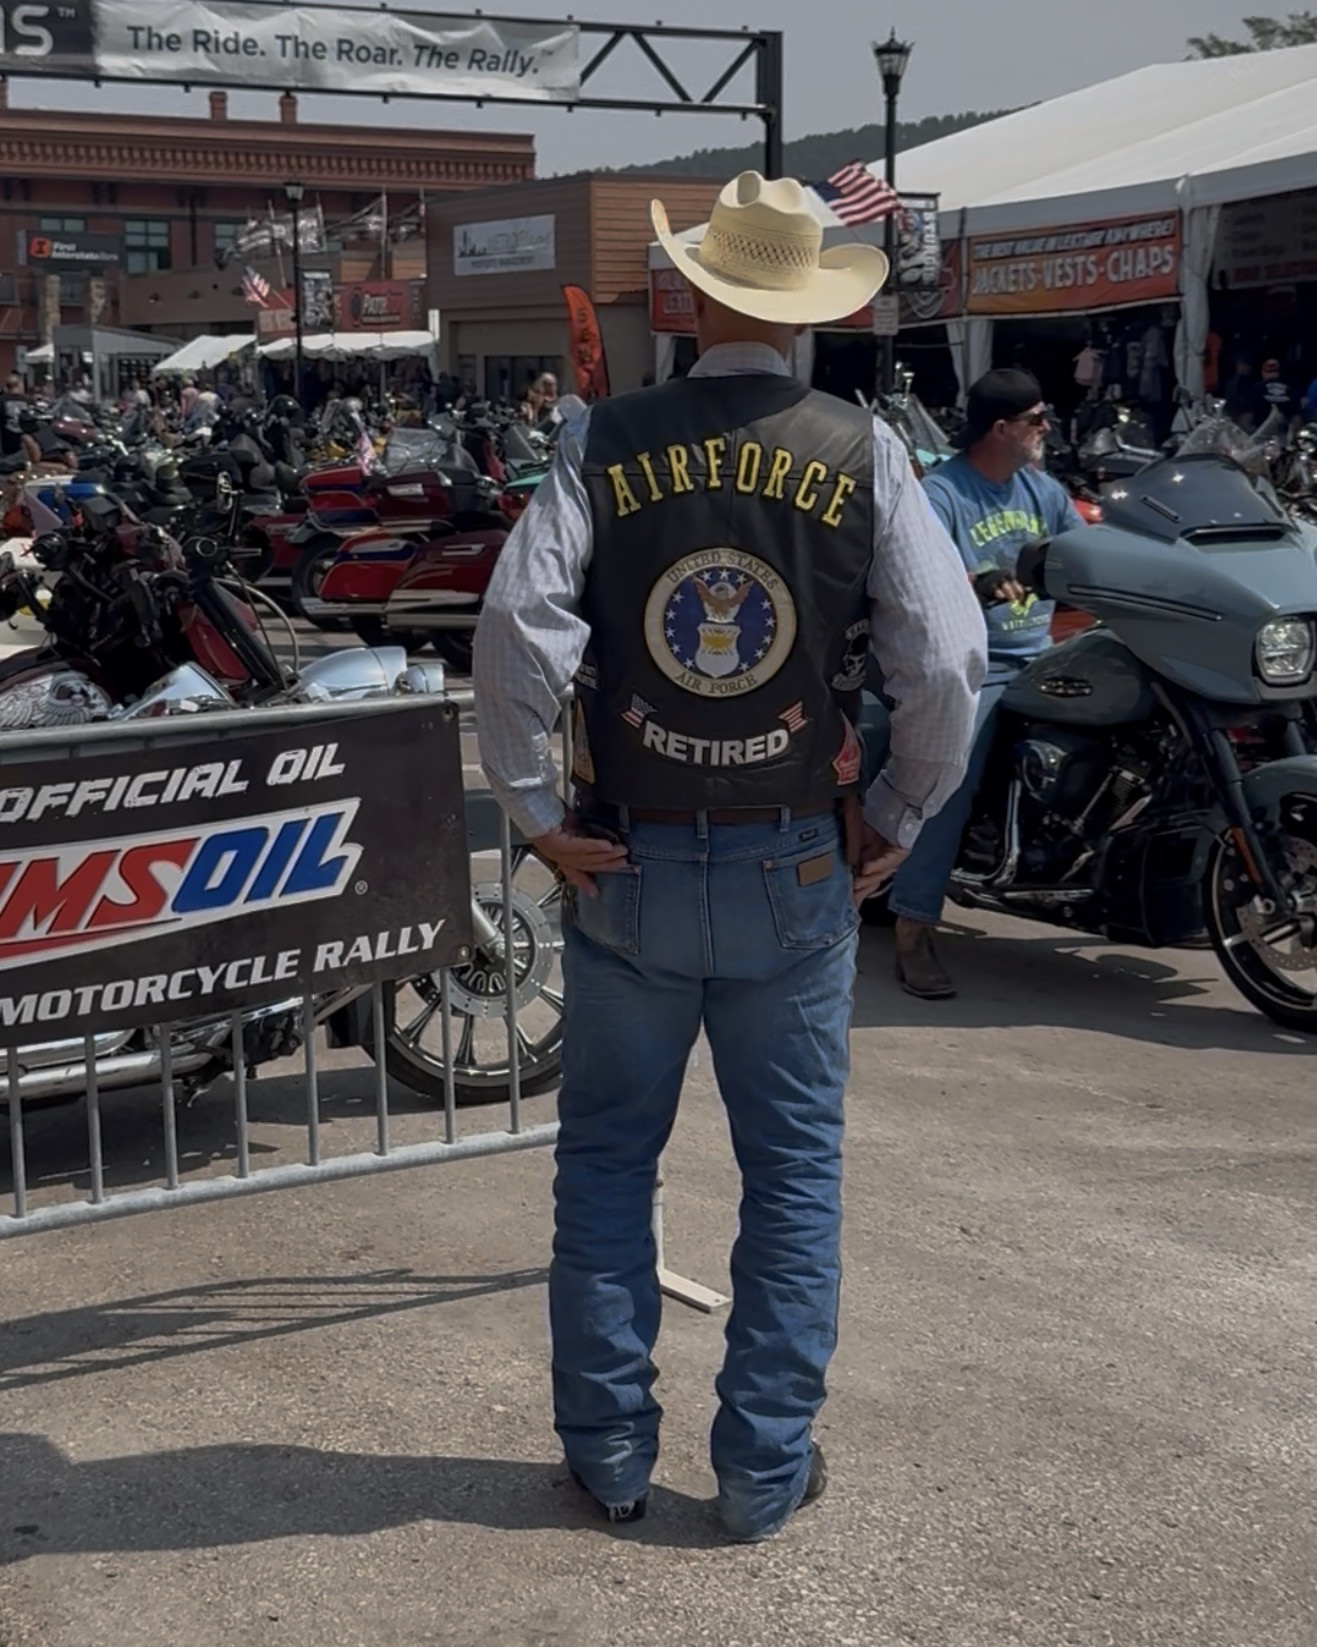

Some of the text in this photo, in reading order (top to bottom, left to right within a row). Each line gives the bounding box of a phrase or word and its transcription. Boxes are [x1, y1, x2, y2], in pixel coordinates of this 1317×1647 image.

[0, 4, 53, 56] S
[127, 26, 181, 52] The
[193, 30, 265, 57] Ride.
[275, 34, 327, 61] The
[338, 39, 402, 66] Roar.
[412, 45, 459, 70] The
[467, 49, 538, 77] Rally.
[972, 245, 1174, 295] JACKETS VESTS CHAPS
[665, 552, 779, 590] UNITED STATES
[674, 672, 758, 694] AIR FORCE
[642, 719, 790, 767] RETIRED
[0, 742, 346, 824] OFFICIAL OIL
[0, 809, 354, 938] MSOIL
[0, 919, 445, 1026] MOTORCYCLE RALLY
